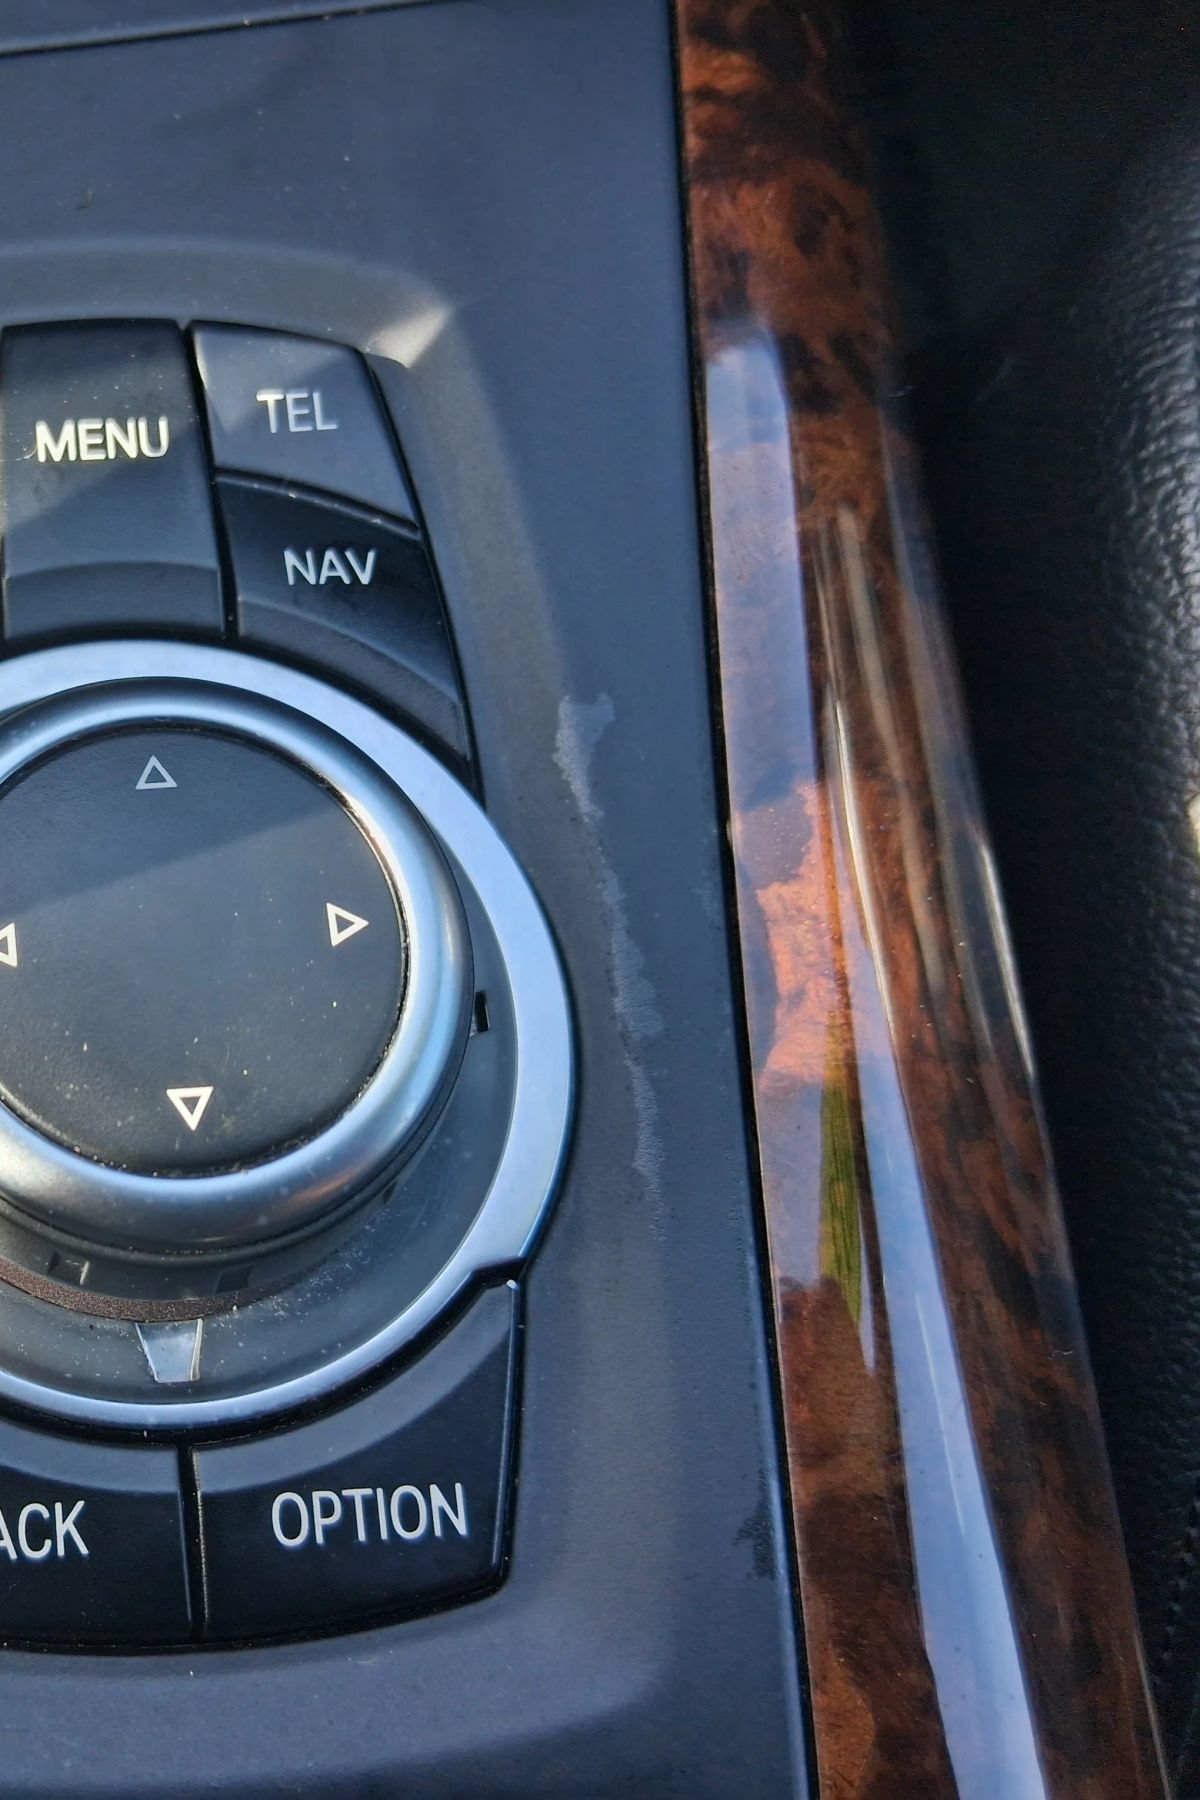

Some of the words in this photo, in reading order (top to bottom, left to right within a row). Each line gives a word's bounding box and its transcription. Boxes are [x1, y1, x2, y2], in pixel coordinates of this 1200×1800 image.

[256, 390, 338, 434] TEL
[35, 415, 170, 462] MENU
[284, 549, 377, 586] NAV
[271, 1483, 469, 1547] OPTION
